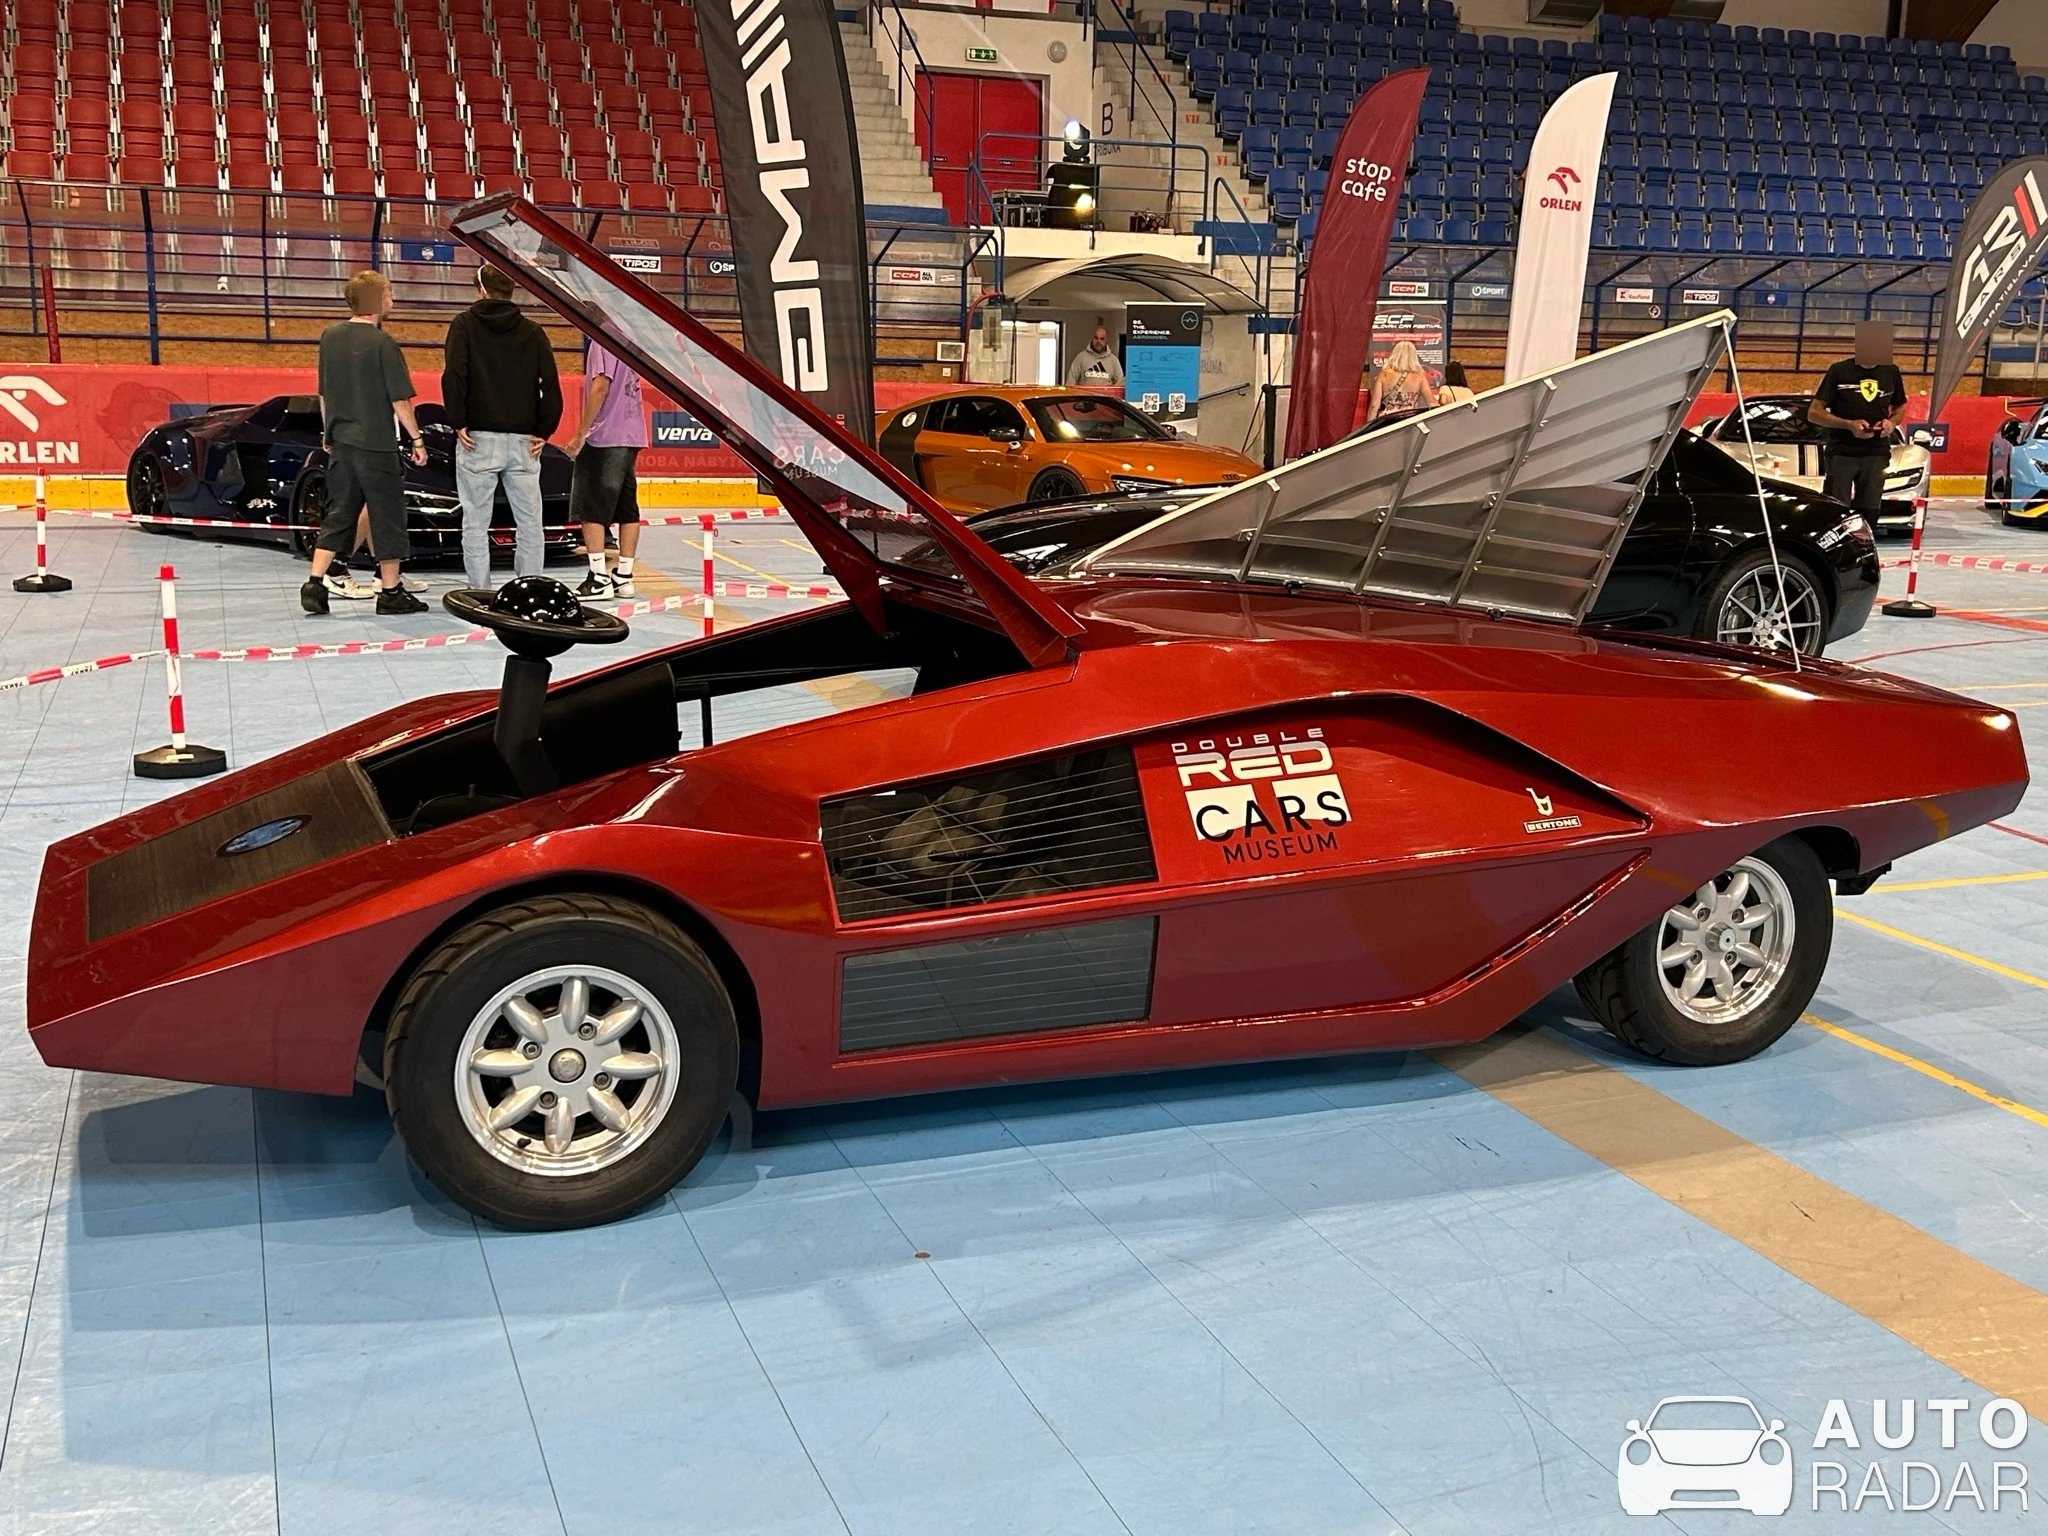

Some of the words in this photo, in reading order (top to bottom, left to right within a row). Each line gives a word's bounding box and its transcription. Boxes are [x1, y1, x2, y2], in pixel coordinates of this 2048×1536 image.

[1102, 102, 1113, 136] B
[1341, 180, 1387, 201] cafe
[1540, 197, 1582, 211] ORLEN
[624, 259, 658, 268] TIPOS
[1482, 287, 1505, 295] SPORT
[1693, 293, 1717, 301] TIPOS
[1982, 253, 2035, 327] BRATISLAVA
[1373, 315, 1415, 325] SCF
[1085, 370, 1109, 379] adidas
[657, 427, 713, 441] verva
[0, 441, 79, 464] RLEN
[638, 455, 679, 467] ROBA
[1171, 728, 1324, 753] DOUBLE
[1174, 740, 1333, 787] RED
[1196, 791, 1347, 842] CARS
[1527, 818, 1579, 831] BERTONE
[1222, 831, 1339, 864] MUSEUM
